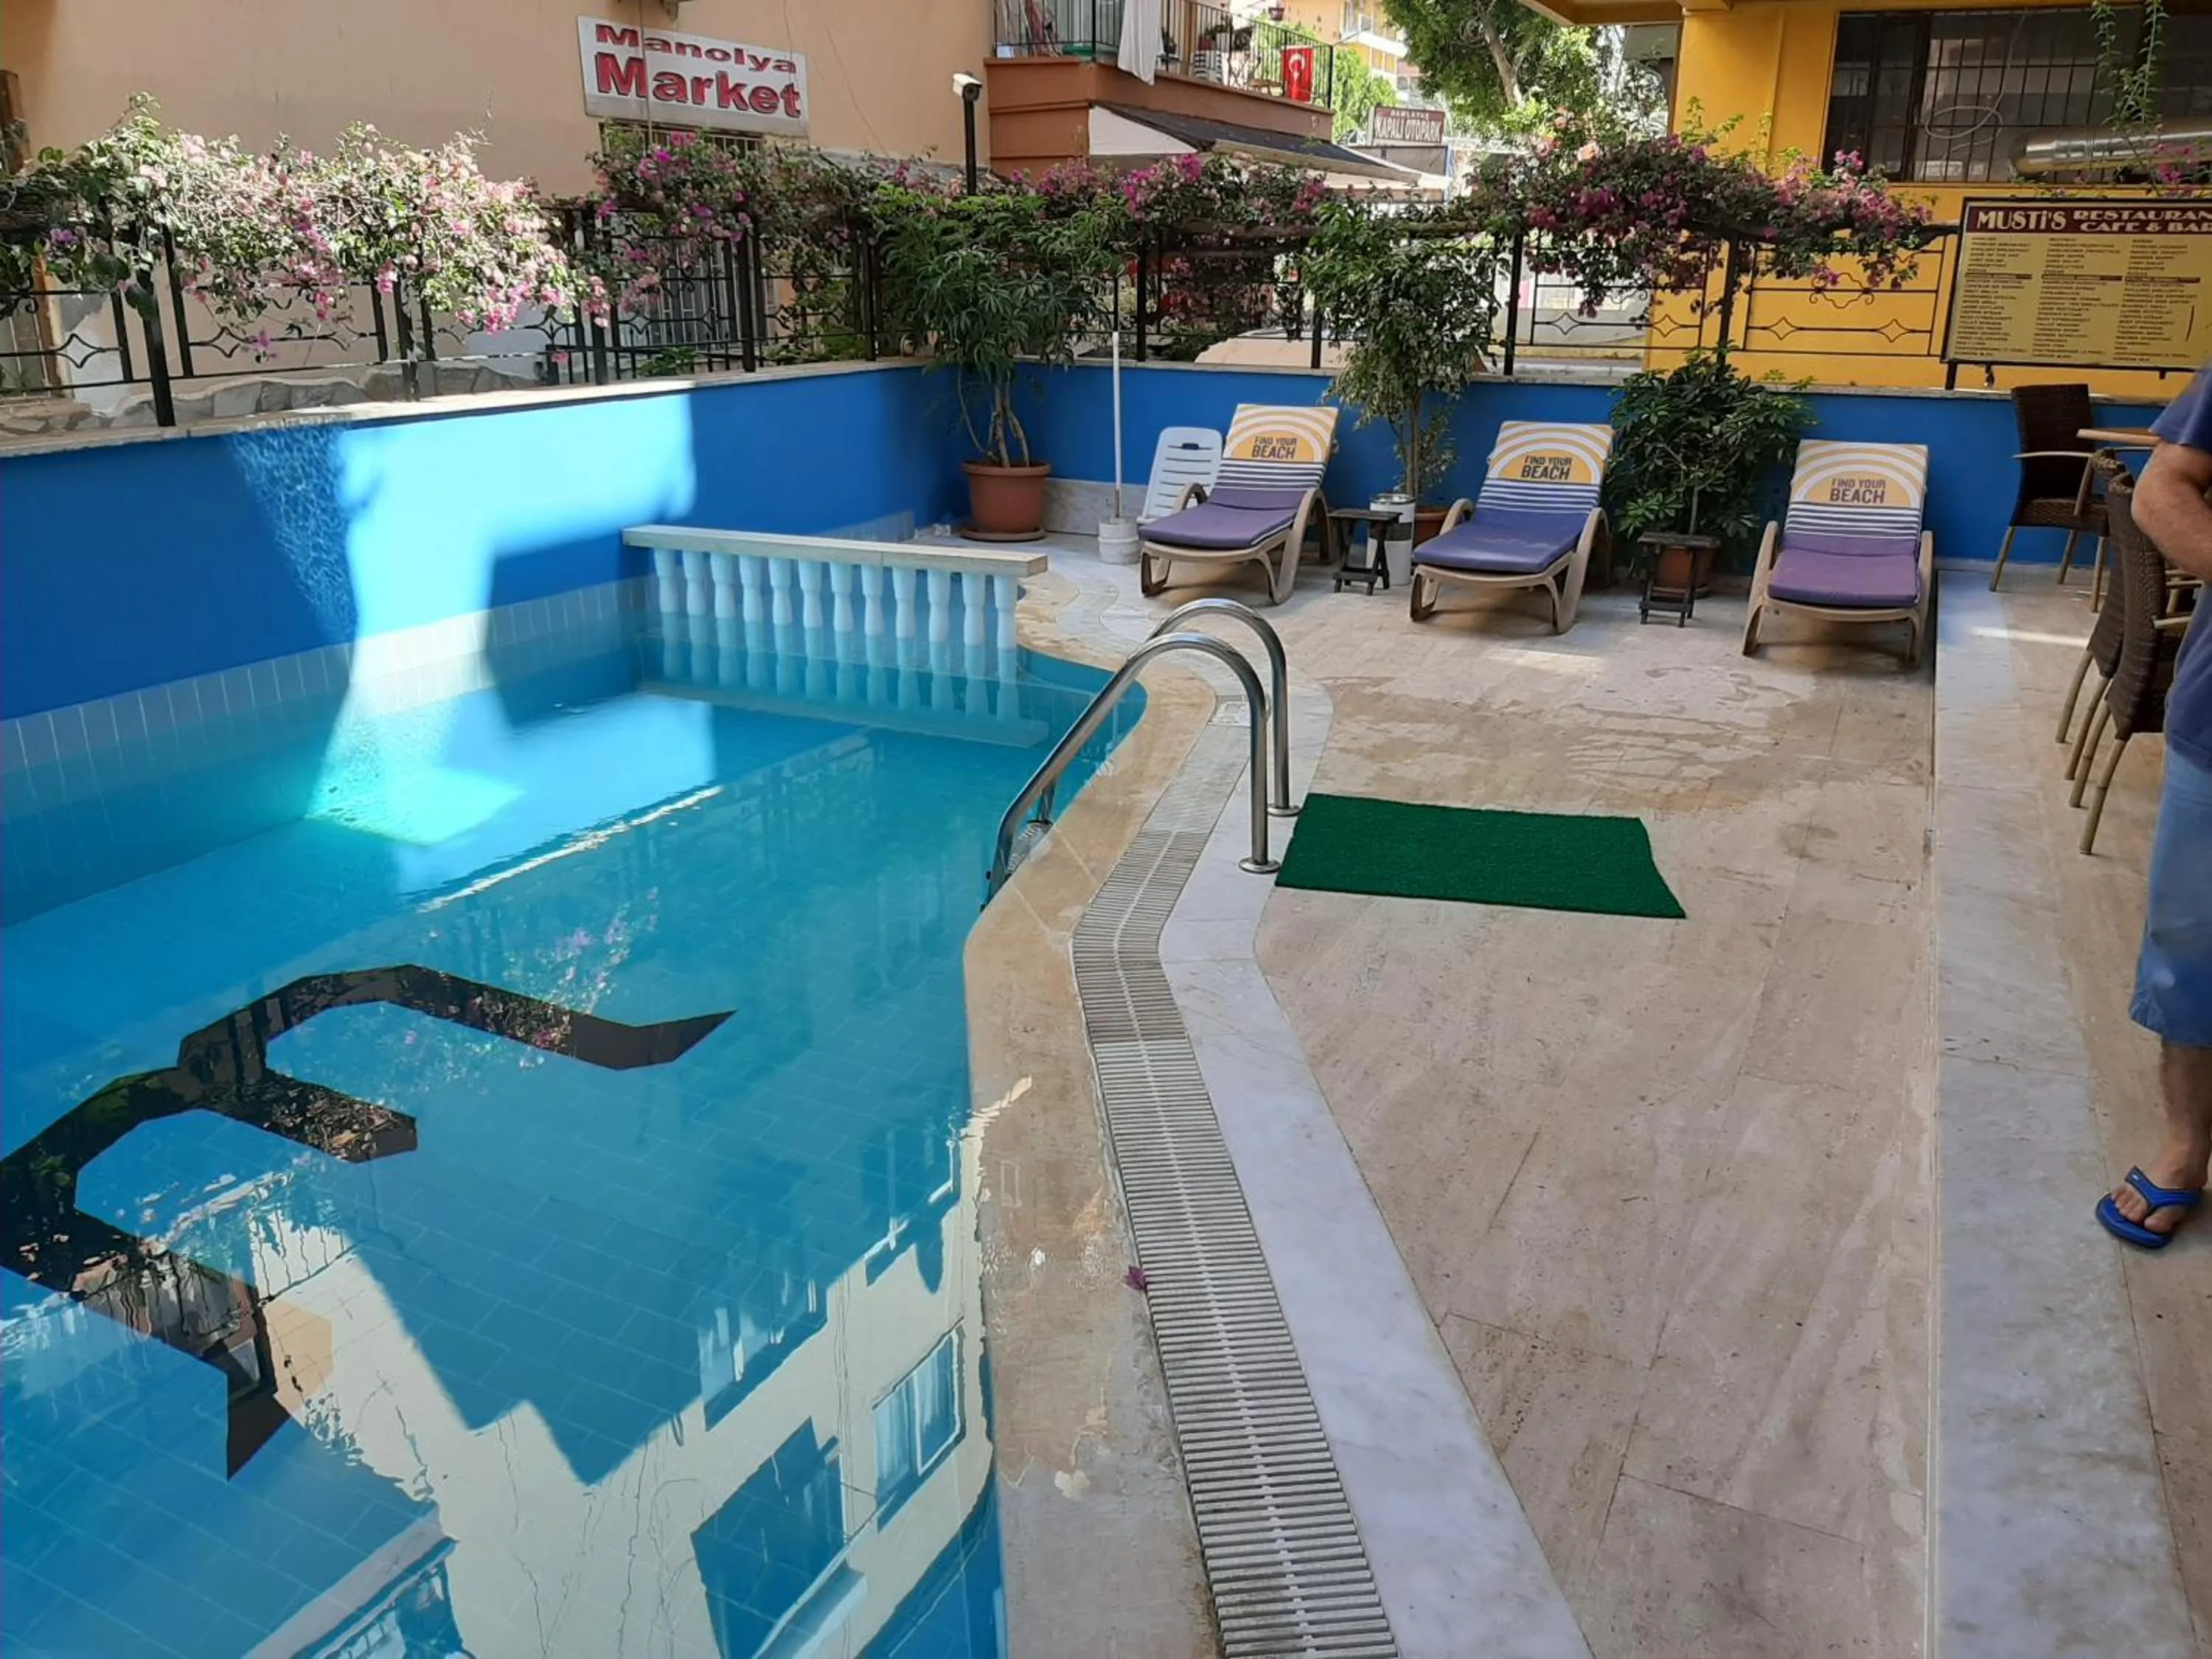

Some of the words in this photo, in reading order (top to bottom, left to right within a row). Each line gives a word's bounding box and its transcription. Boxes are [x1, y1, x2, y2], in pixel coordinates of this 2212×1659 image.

[595, 24, 797, 74] Manolya
[594, 52, 801, 118] Market
[1405, 119, 1441, 142] OTOPARK
[2080, 222, 2140, 232] CAFE
[2146, 222, 2162, 232] &
[1254, 436, 1273, 444] FIND
[1276, 437, 1298, 445] YOUR
[1251, 445, 1296, 459] BEACH
[1525, 456, 1545, 465] FIND
[1548, 457, 1573, 467] YOUR
[1521, 465, 1571, 481] BEACH
[1832, 478, 1855, 488] FIND
[1858, 479, 1886, 490] YOUR
[1830, 488, 1885, 504] BEACH
